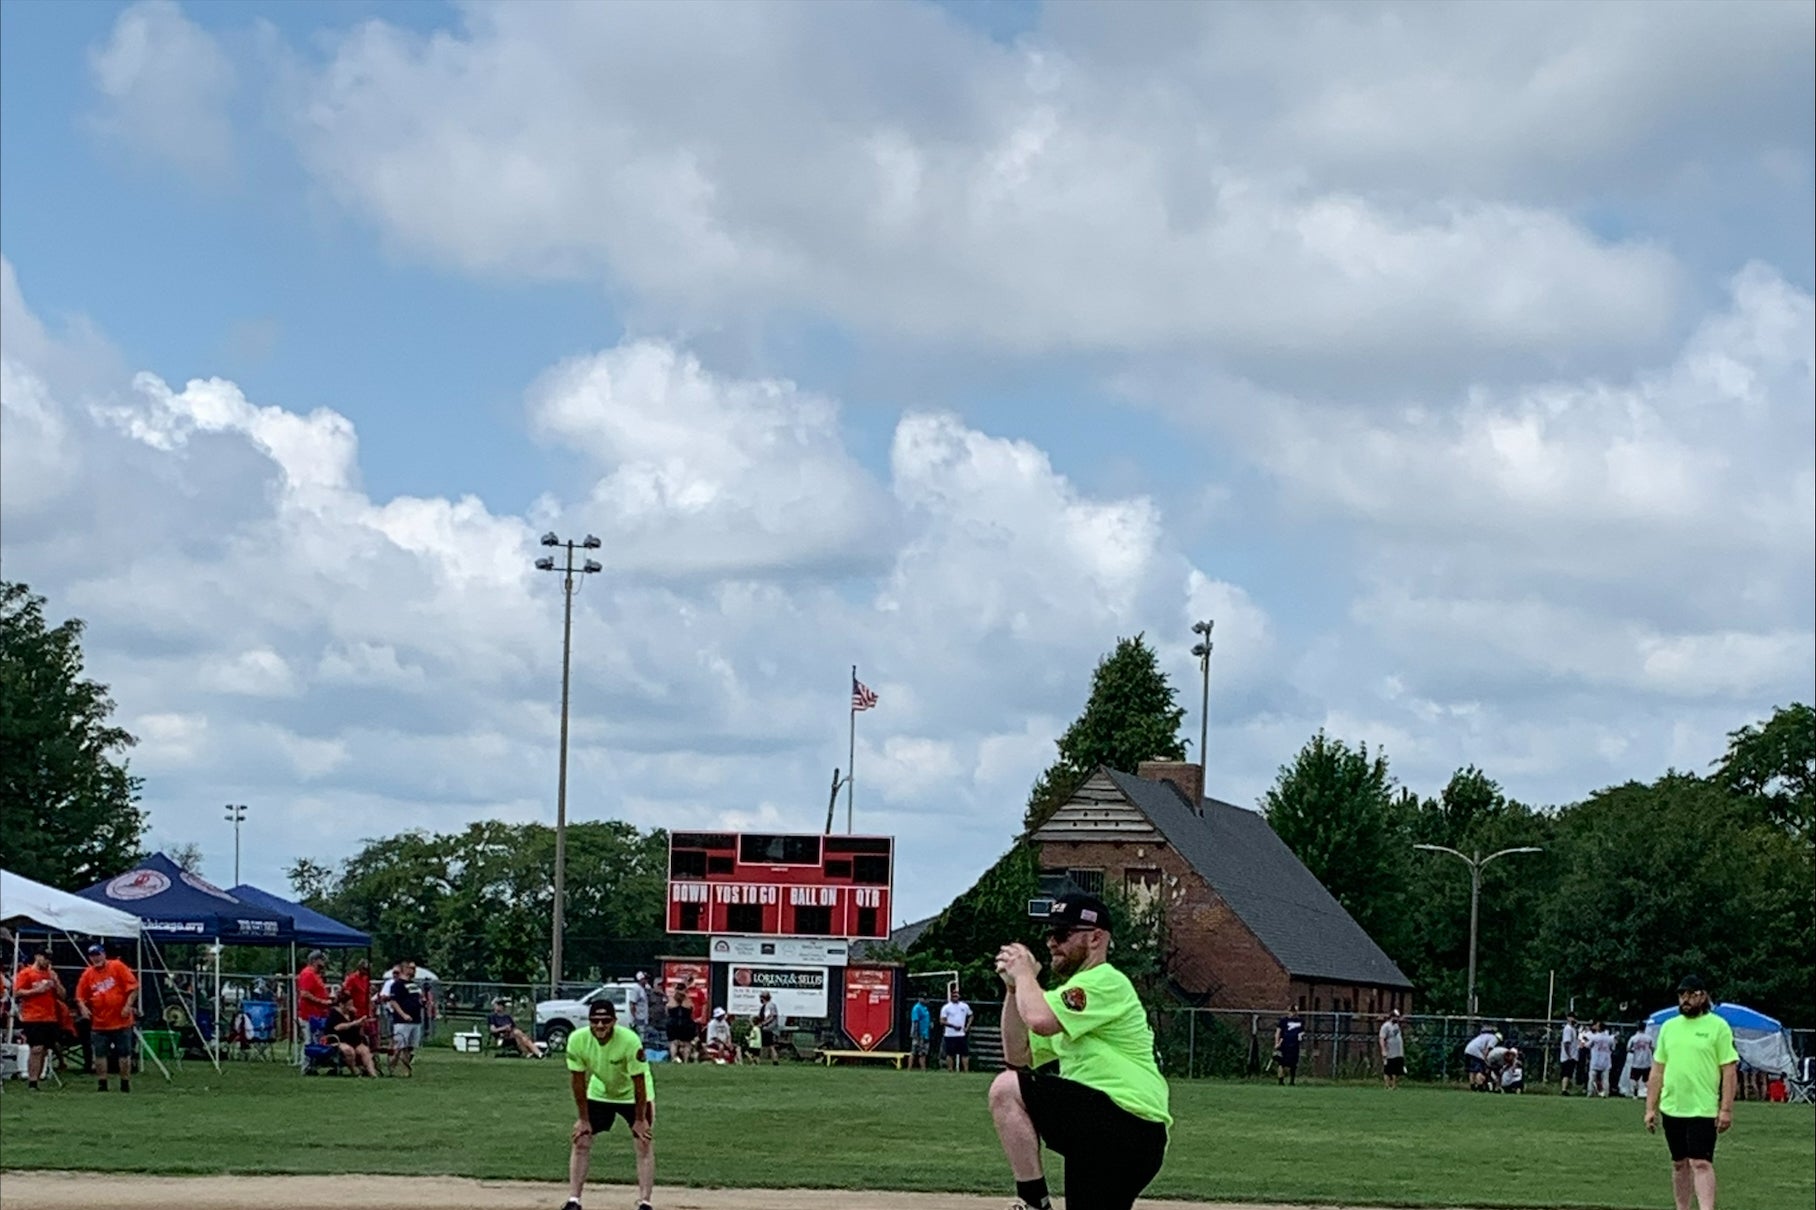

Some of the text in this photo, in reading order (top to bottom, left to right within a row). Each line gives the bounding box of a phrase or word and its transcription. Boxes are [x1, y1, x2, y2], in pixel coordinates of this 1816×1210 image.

[672, 884, 708, 903] DOWN
[716, 886, 777, 905] YDS TO GO
[790, 887, 837, 906] BALL ON
[855, 889, 880, 908] QTR
